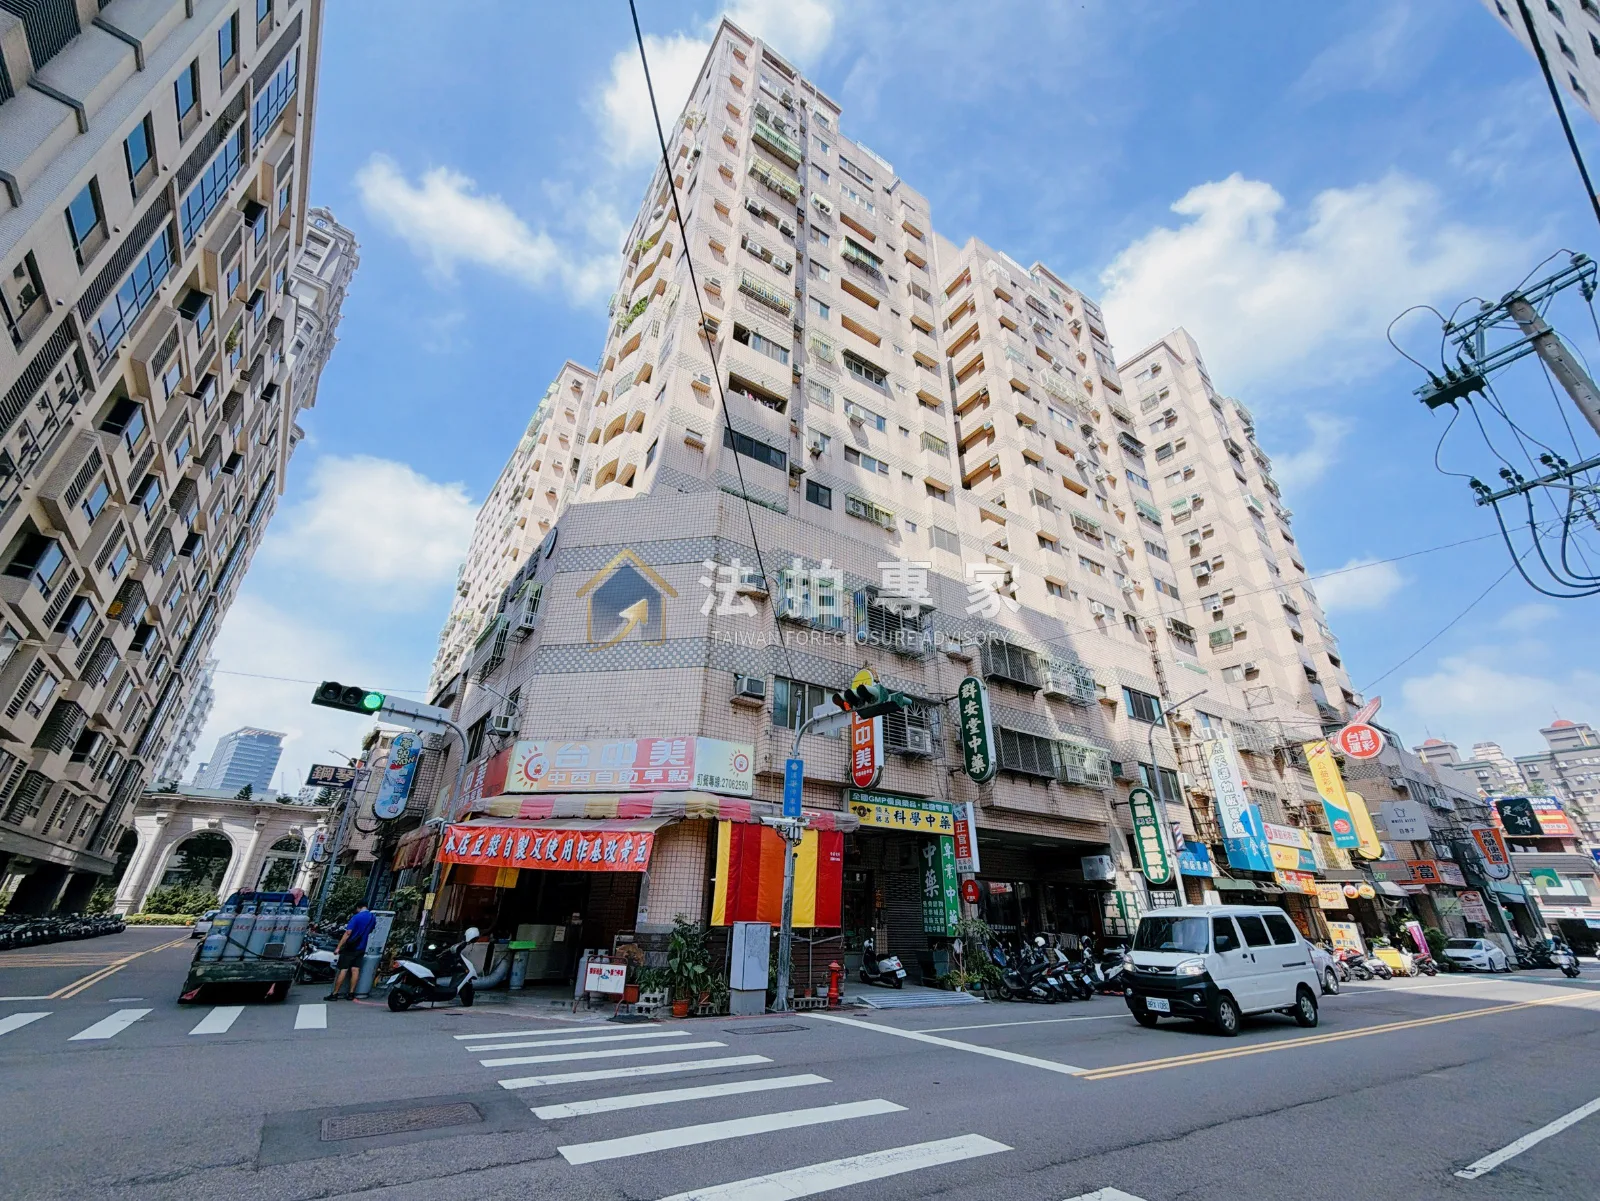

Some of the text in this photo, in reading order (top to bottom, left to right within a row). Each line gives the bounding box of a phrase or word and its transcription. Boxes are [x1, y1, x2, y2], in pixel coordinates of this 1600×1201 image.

[961, 681, 986, 774] 群安堂中藥
[554, 740, 689, 768] 台中美
[311, 766, 356, 783] 鋼琴
[547, 768, 689, 785] 中西自助早點
[893, 809, 952, 830] 科學中藥
[955, 822, 969, 857] 正官庄
[922, 841, 940, 898] 中藥
[943, 842, 959, 928] 專業中藥
